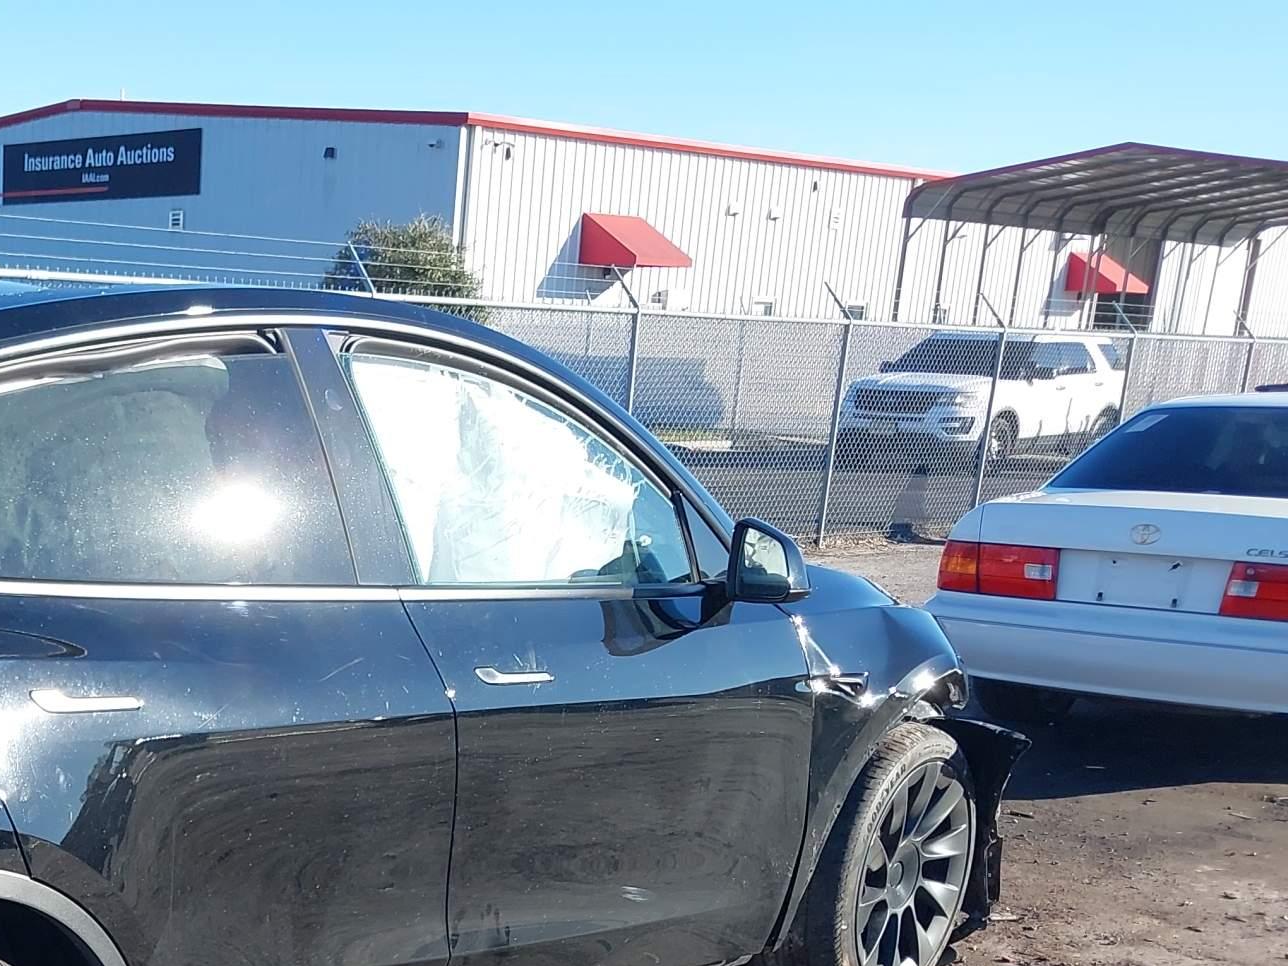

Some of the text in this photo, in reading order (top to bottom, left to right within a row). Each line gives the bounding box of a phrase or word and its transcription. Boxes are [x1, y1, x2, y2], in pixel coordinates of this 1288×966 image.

[23, 143, 175, 172] Insurance Auto Auctions
